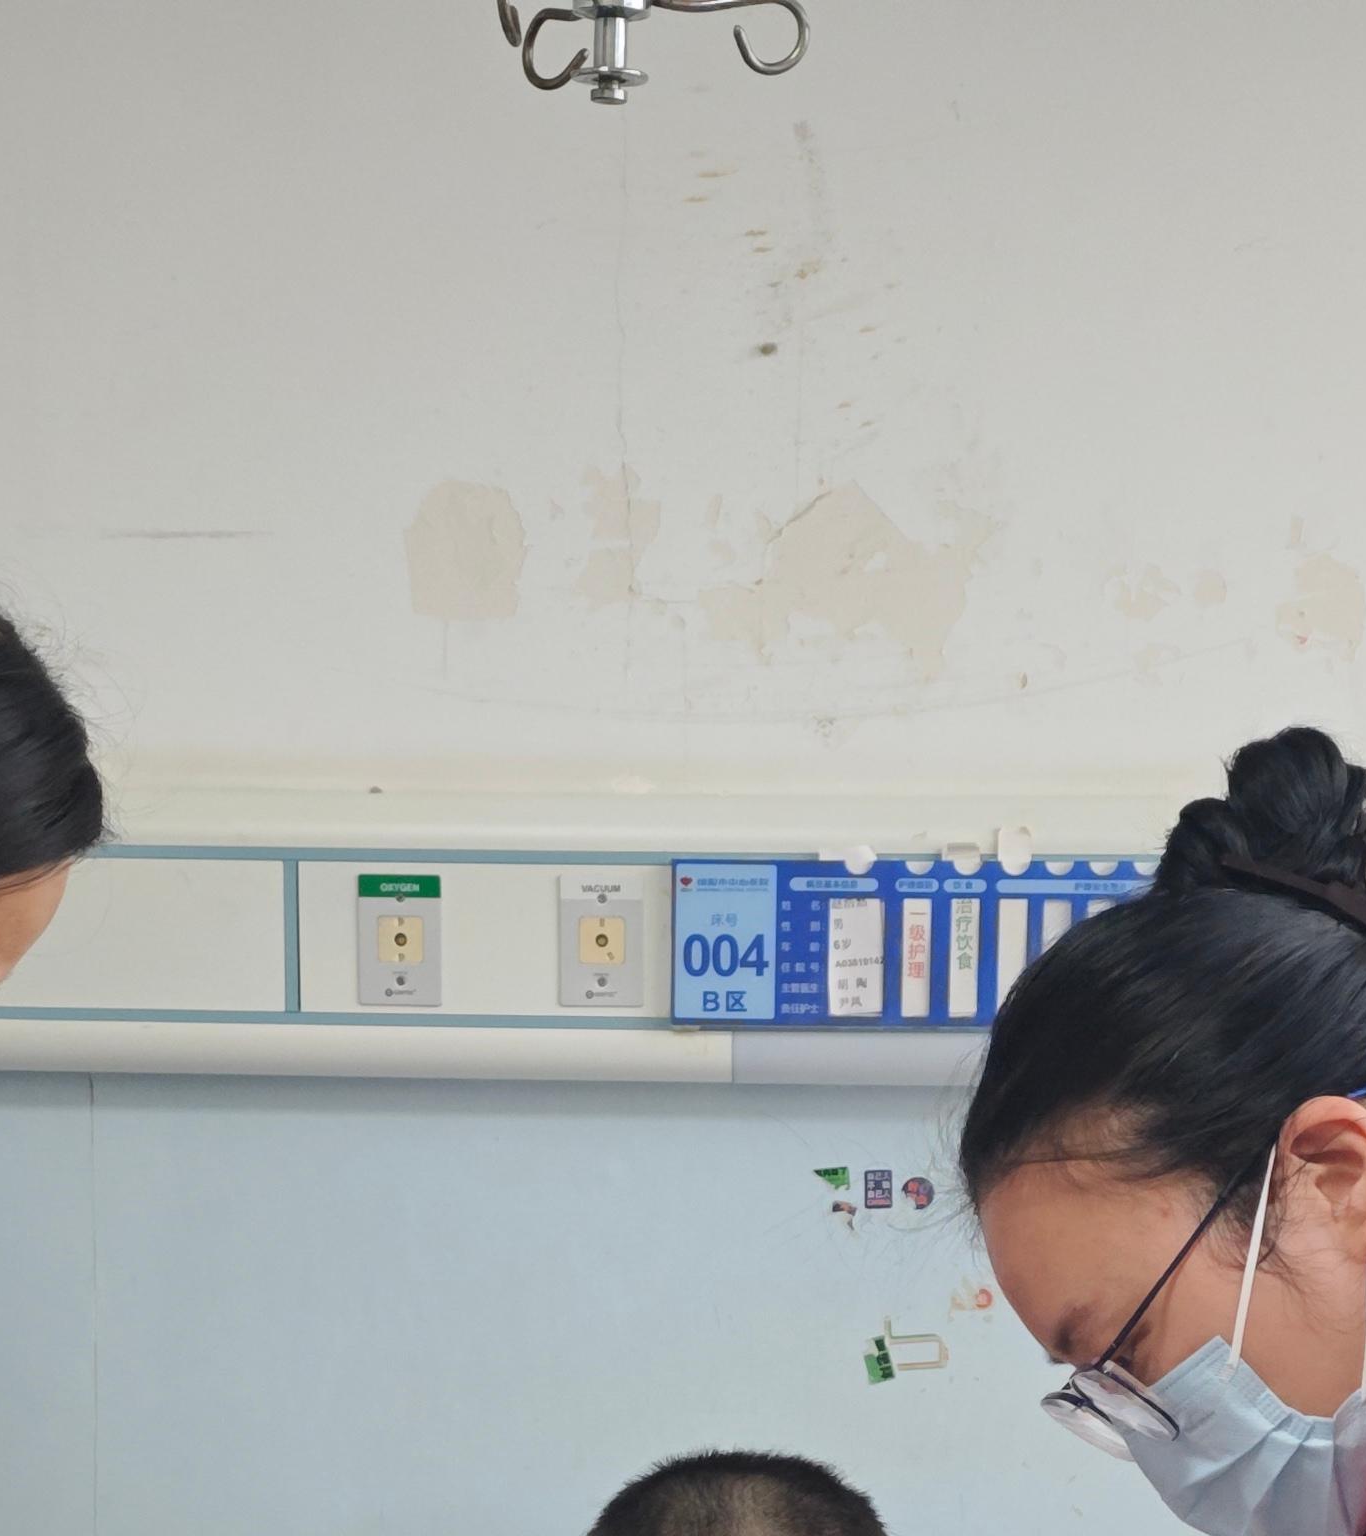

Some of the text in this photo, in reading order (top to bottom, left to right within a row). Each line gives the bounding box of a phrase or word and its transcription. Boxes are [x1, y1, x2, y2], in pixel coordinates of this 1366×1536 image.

[379, 882, 420, 892] OXYGEN
[581, 884, 621, 893] VACUUM
[710, 913, 738, 927] 床号
[955, 898, 973, 970] 治疗饮食
[833, 938, 852, 950] 6岁
[907, 911, 926, 979] 一级护理
[683, 933, 770, 977] 004
[702, 990, 747, 1012] B区
